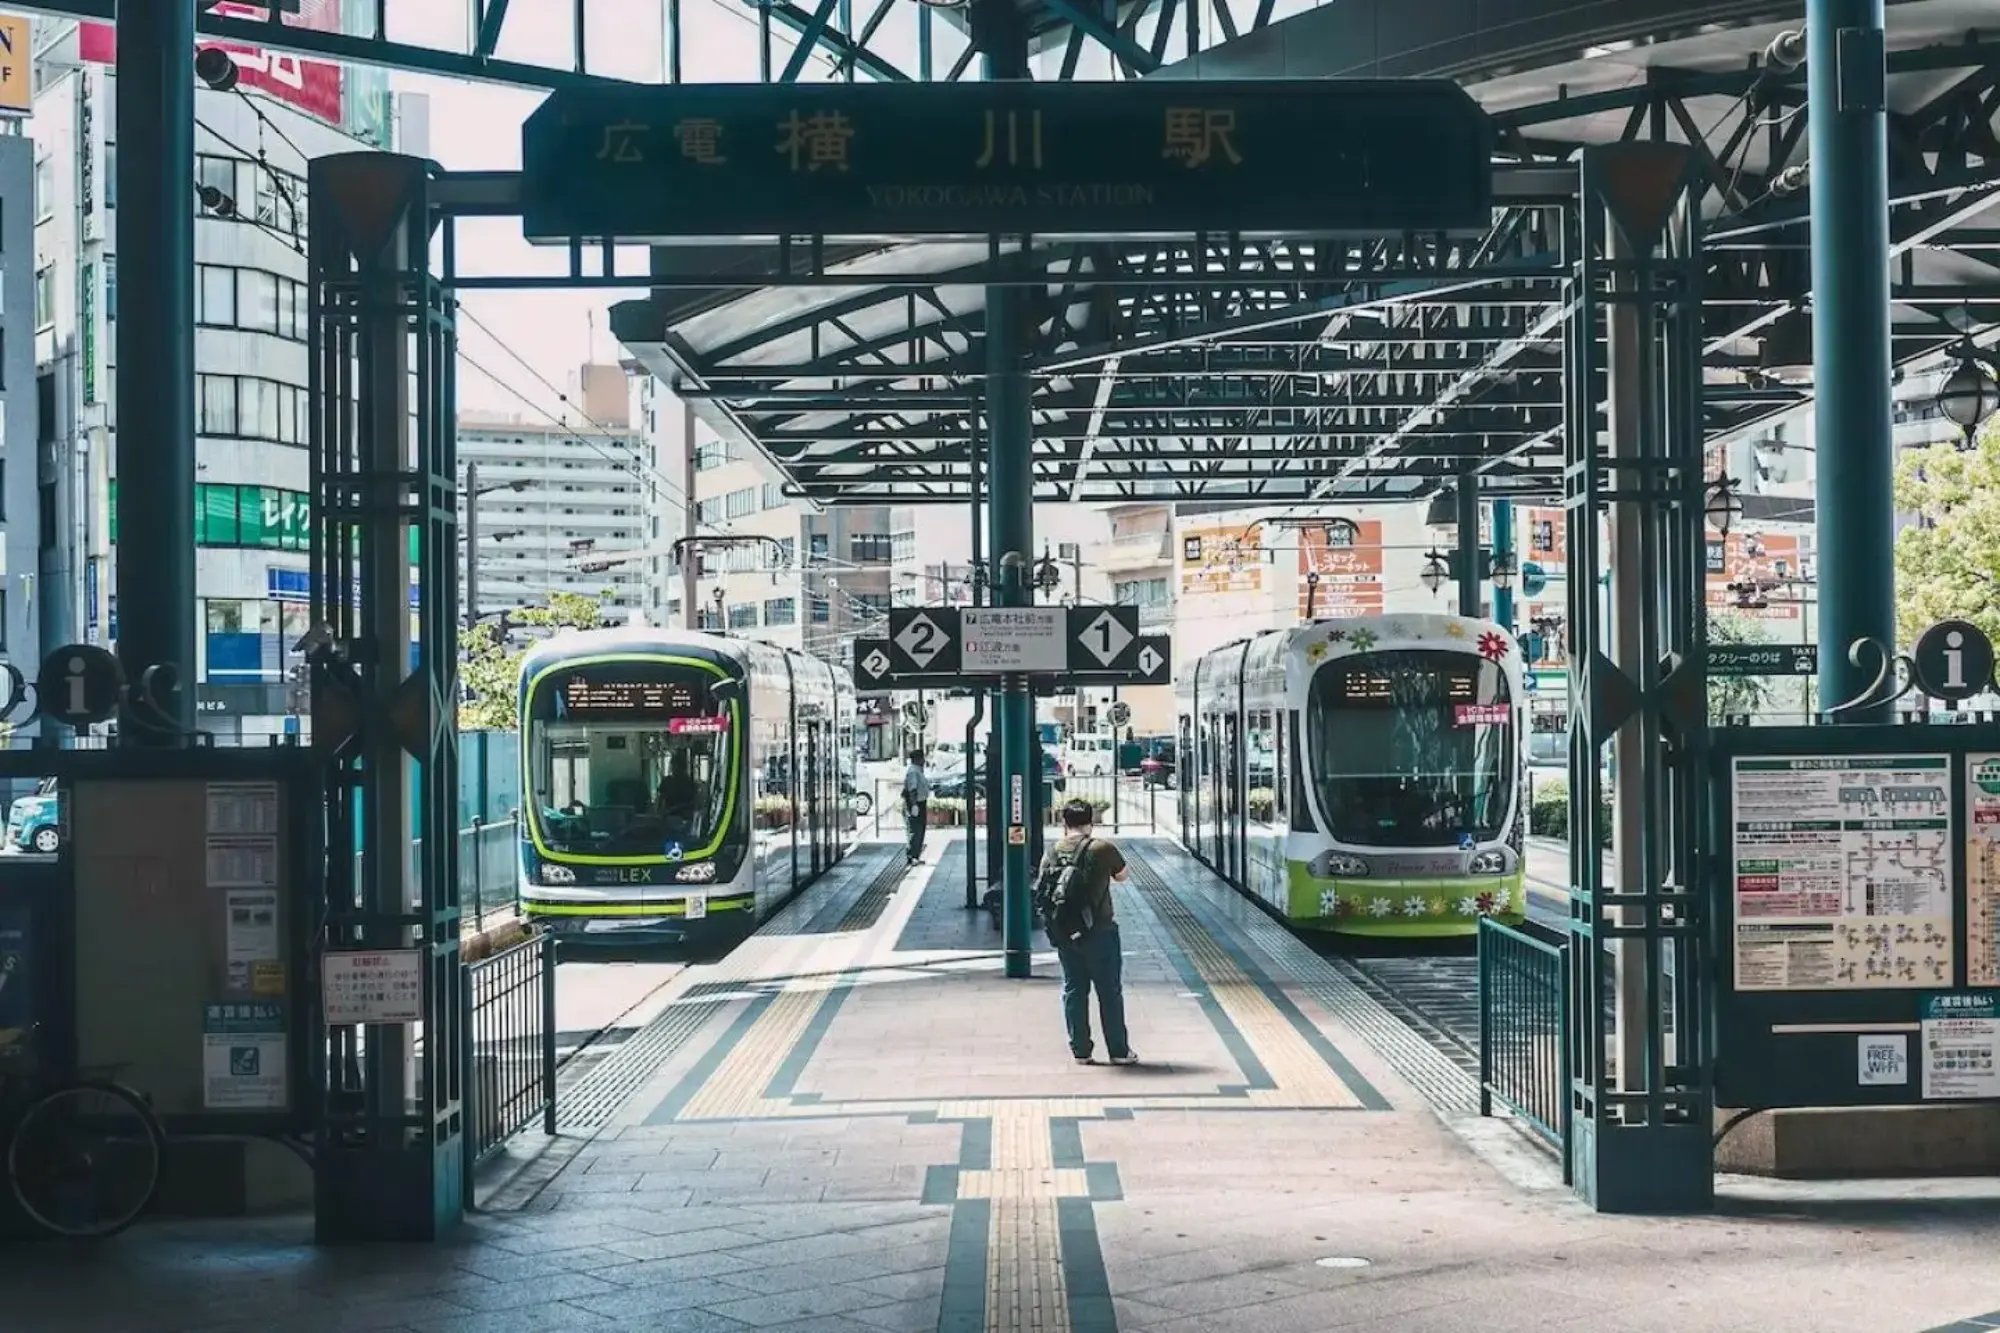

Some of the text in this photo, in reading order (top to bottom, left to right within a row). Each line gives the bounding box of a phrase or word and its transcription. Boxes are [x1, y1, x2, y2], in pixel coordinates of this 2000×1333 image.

[773, 106, 1245, 172] 横川駅
[865, 184, 1156, 208] YOKOGAWA STATION
[910, 622, 935, 655] 2
[1093, 620, 1111, 653] 1
[1707, 652, 1782, 665] タクシーのりば
[1791, 647, 1816, 656] TAXI
[870, 656, 883, 672] 2
[1143, 652, 1152, 669] 1
[619, 867, 653, 882] LEX
[1867, 1049, 1895, 1060] FREE
